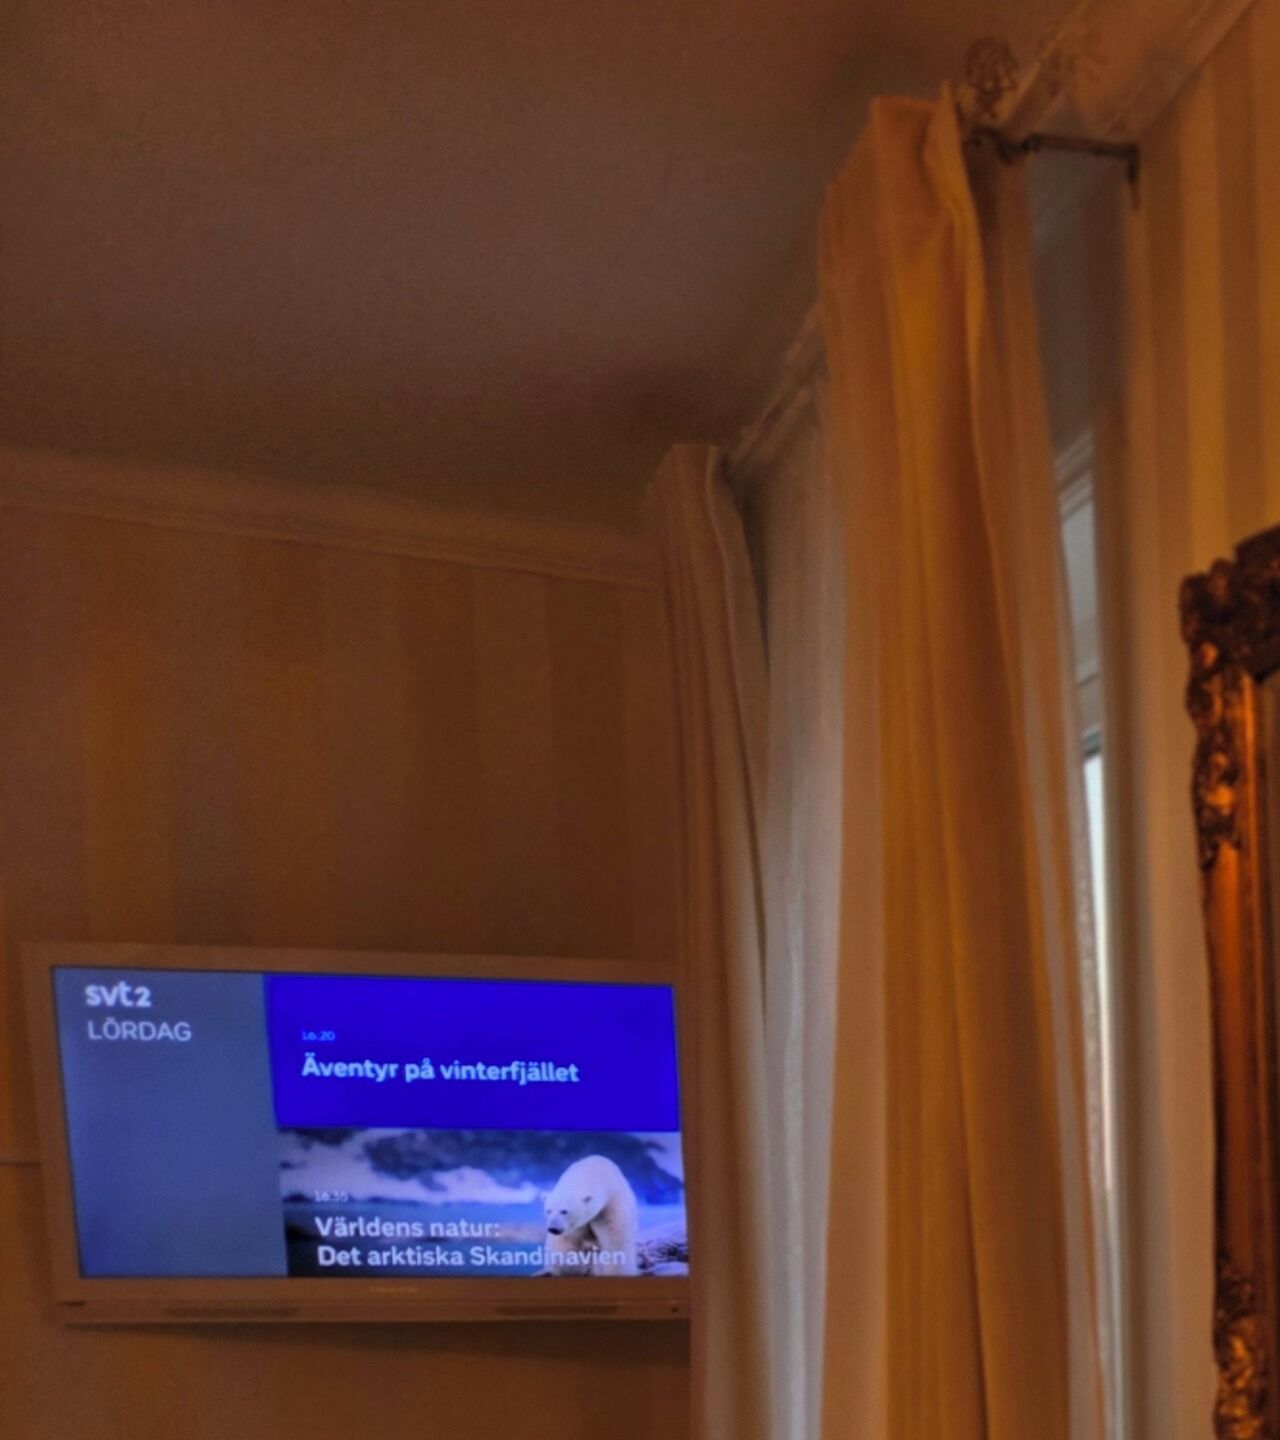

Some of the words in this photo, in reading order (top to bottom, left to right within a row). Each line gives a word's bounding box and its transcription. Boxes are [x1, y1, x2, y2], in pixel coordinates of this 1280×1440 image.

[85, 981, 151, 1007] svt2
[87, 1016, 192, 1041] LÖRDAG
[301, 1051, 399, 1083] Äventyr
[404, 1057, 435, 1083] på
[439, 1060, 580, 1086] vinterfjället
[314, 1216, 423, 1237] Världens
[430, 1219, 500, 1238] natur:
[317, 1246, 361, 1266] Det
[367, 1246, 463, 1266] arktiska
[470, 1245, 626, 1266] Skandinavien
